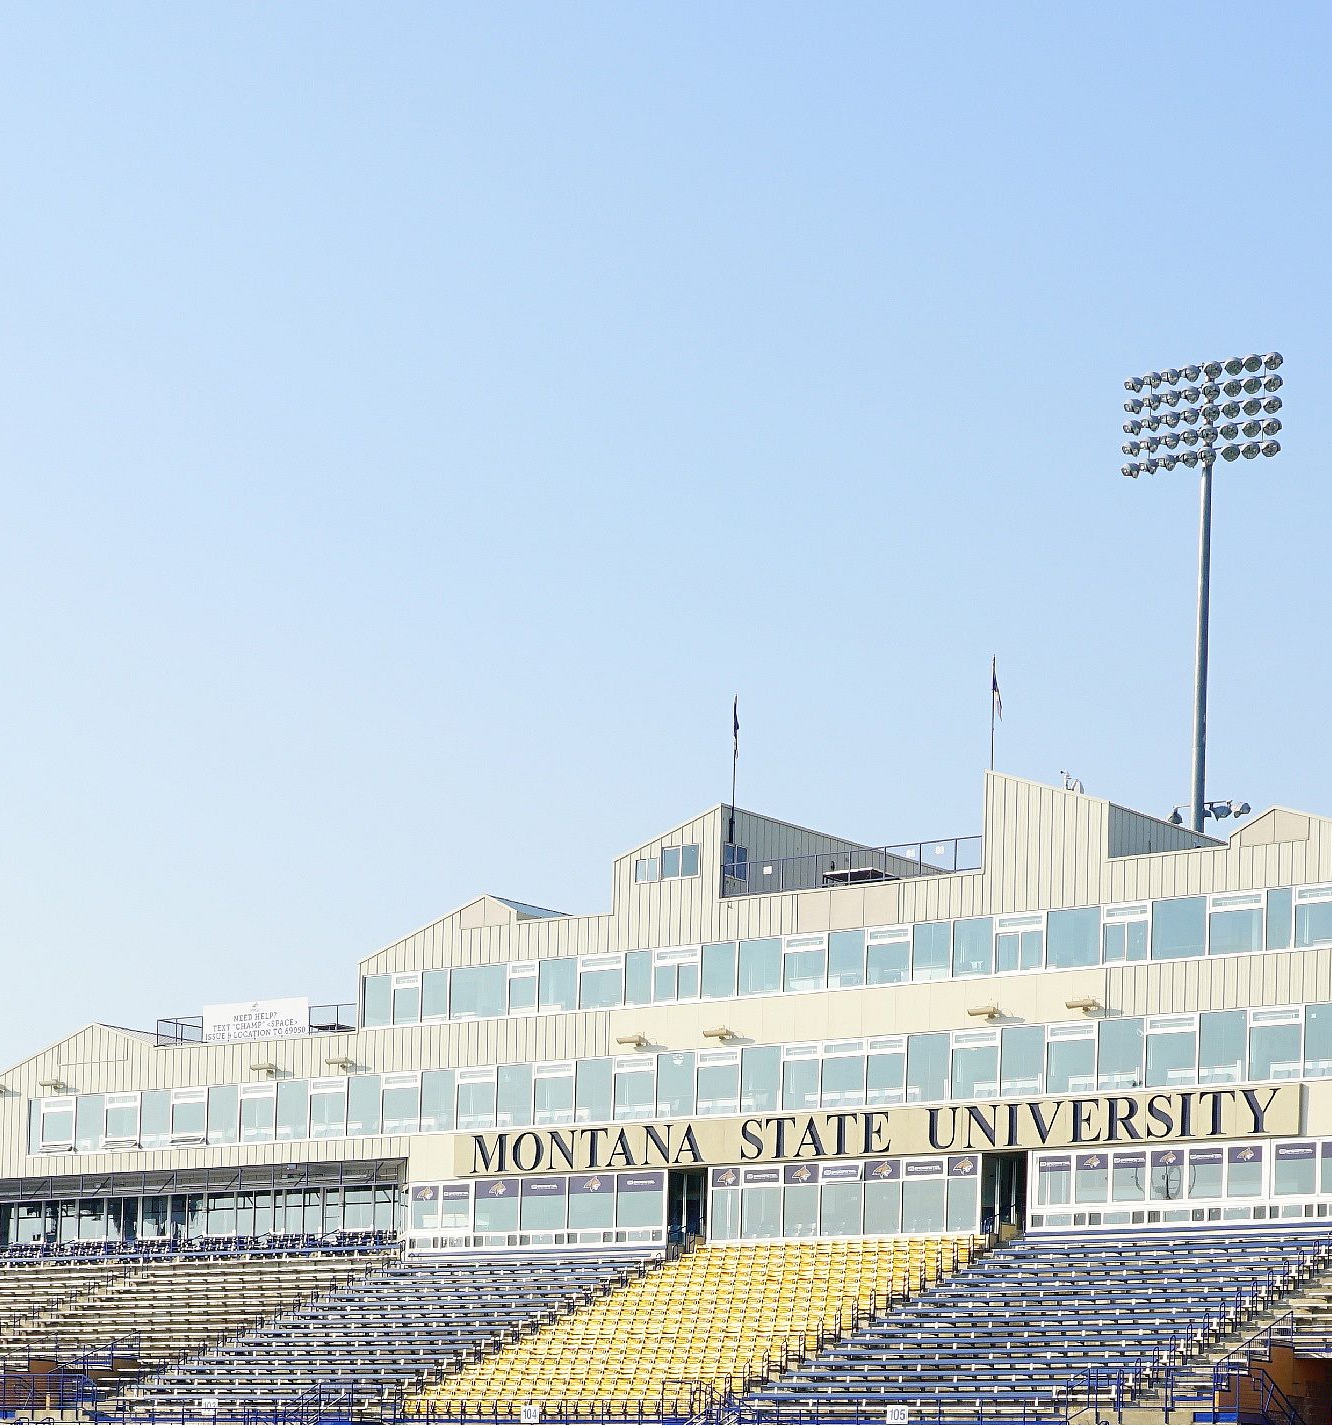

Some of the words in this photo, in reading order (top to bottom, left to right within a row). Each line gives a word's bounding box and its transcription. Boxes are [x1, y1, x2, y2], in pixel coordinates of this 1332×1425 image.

[233, 1014, 253, 1022] NEED
[255, 1011, 278, 1020] HELP?
[205, 1032, 226, 1041] ISSUE
[233, 1029, 271, 1039] LOCATION
[273, 1027, 283, 1035] TO
[213, 1024, 231, 1032] TEXT
[470, 1122, 706, 1174] MONTANA
[739, 1112, 892, 1160] STATE
[925, 1088, 1282, 1150] UNIVERSITY
[523, 1408, 537, 1420] 104
[889, 1408, 906, 1421] 105
